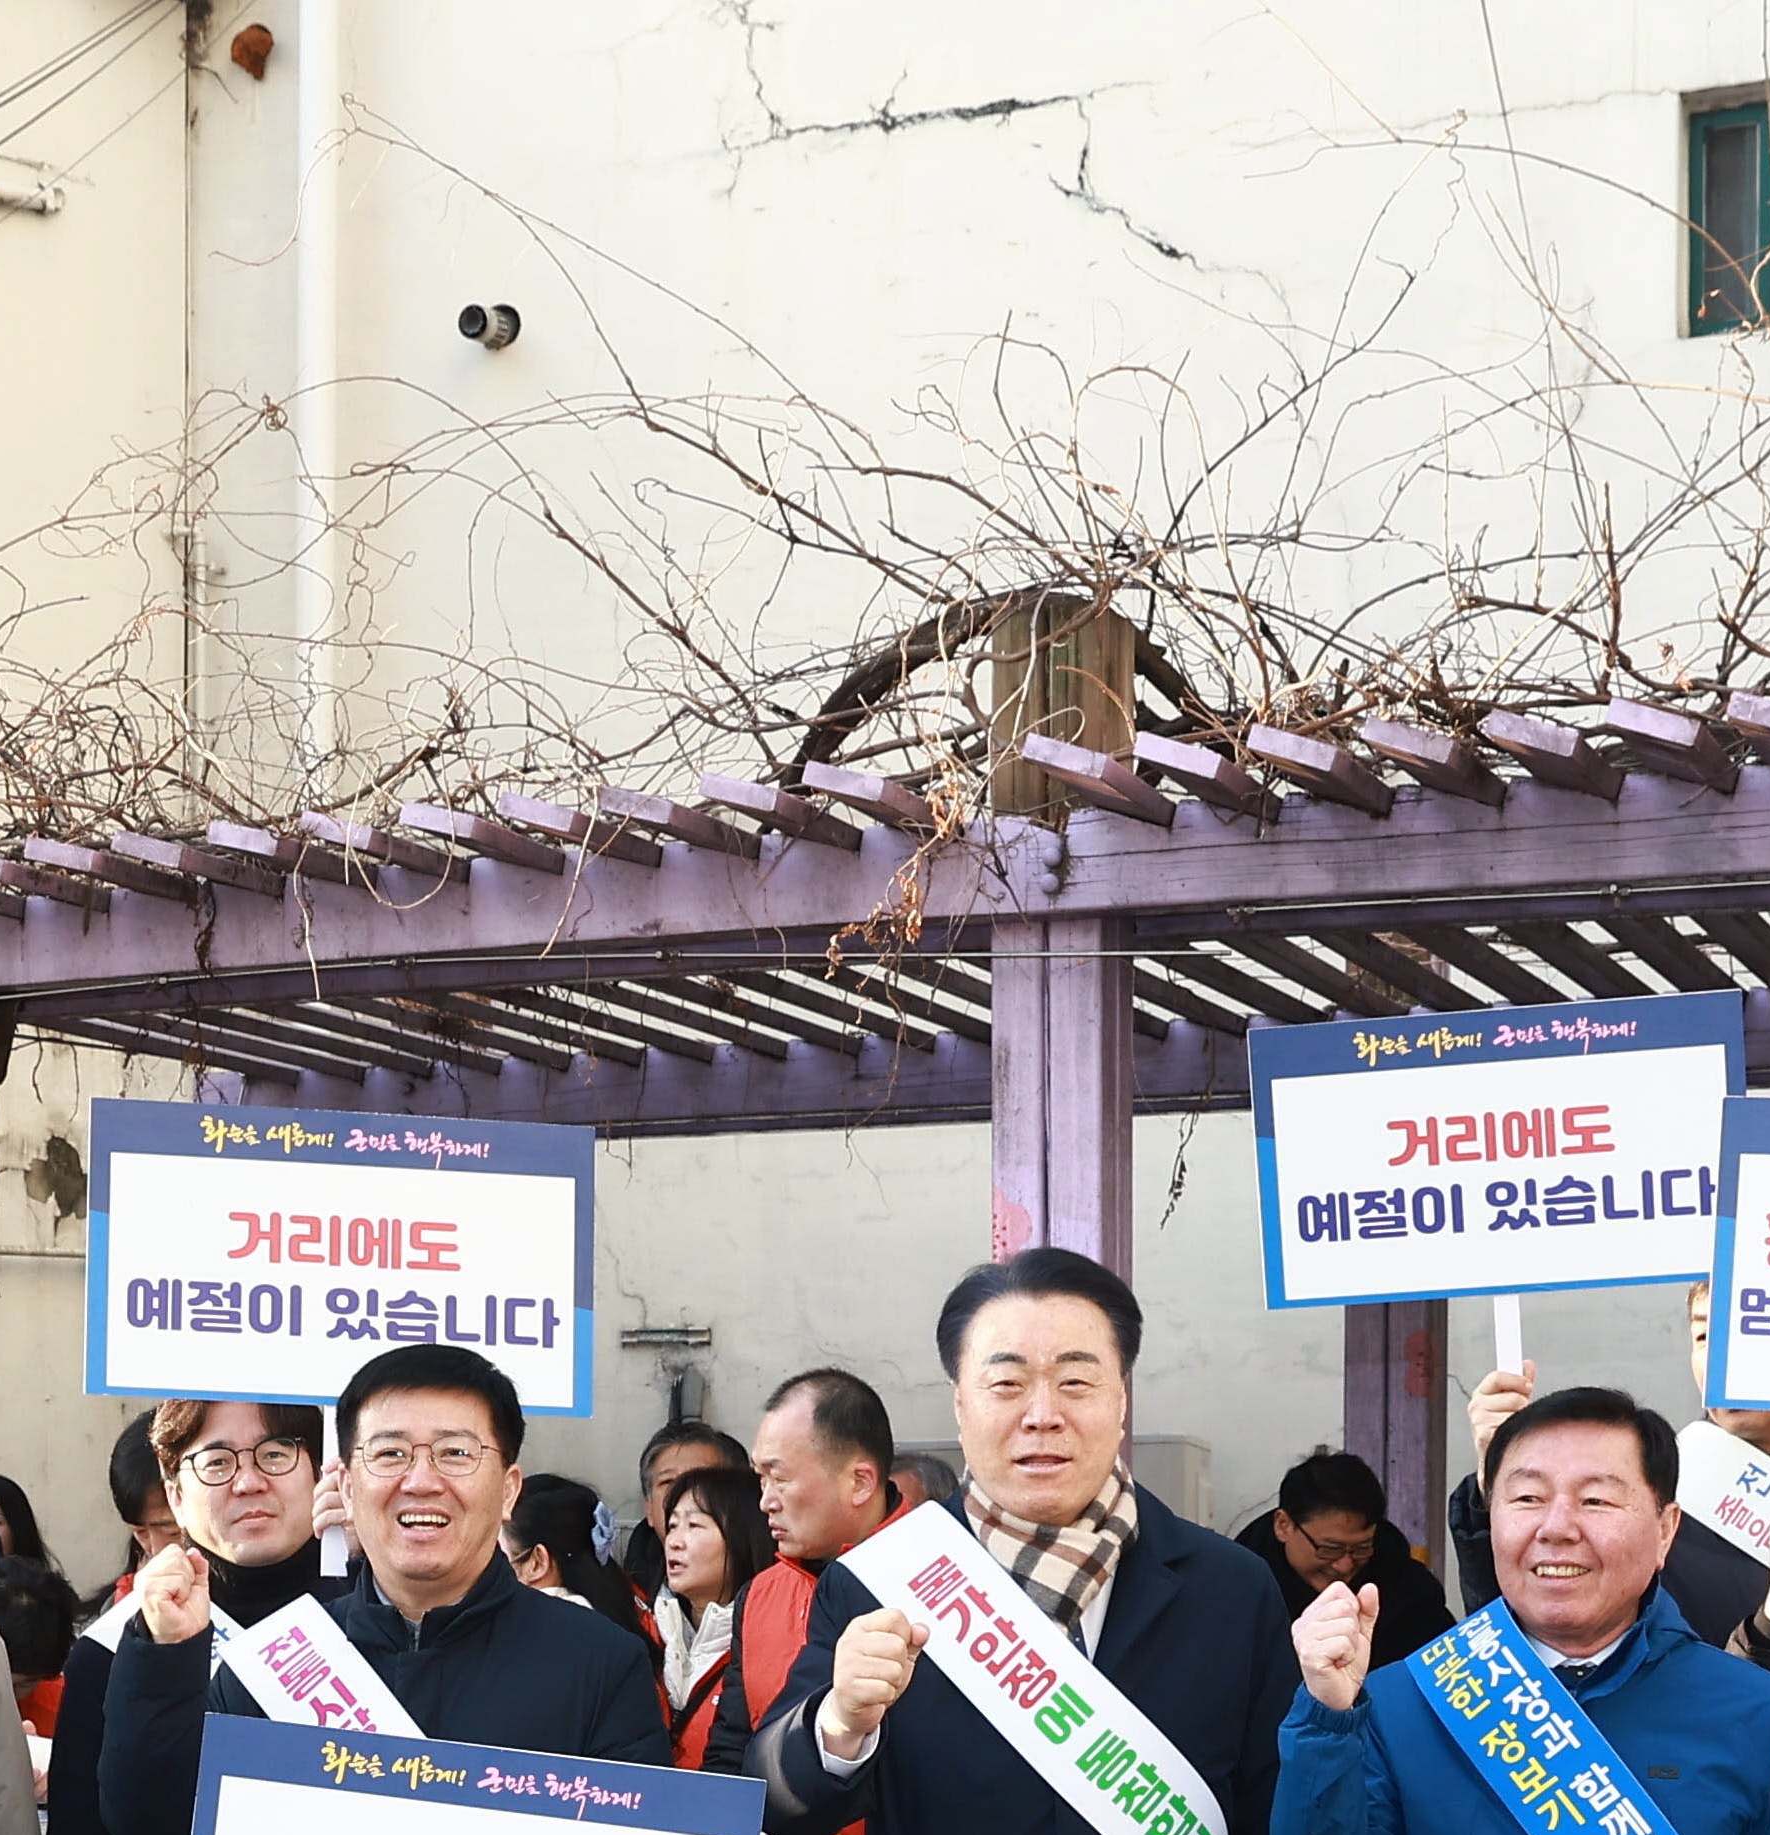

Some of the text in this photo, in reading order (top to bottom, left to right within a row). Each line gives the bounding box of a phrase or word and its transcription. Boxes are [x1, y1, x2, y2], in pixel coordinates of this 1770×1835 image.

[1386, 1104, 1616, 1167] 거리에도
[227, 1211, 462, 1272] 거리에도
[1297, 1165, 1716, 1244] 예절이 있습니다
[127, 1278, 560, 1349] 예절이 있습니다
[908, 1554, 1096, 1745] 물가안정에
[1458, 1611, 1582, 1760] 전통시장과
[1420, 1634, 1586, 1831] 따뜻한 장보기
